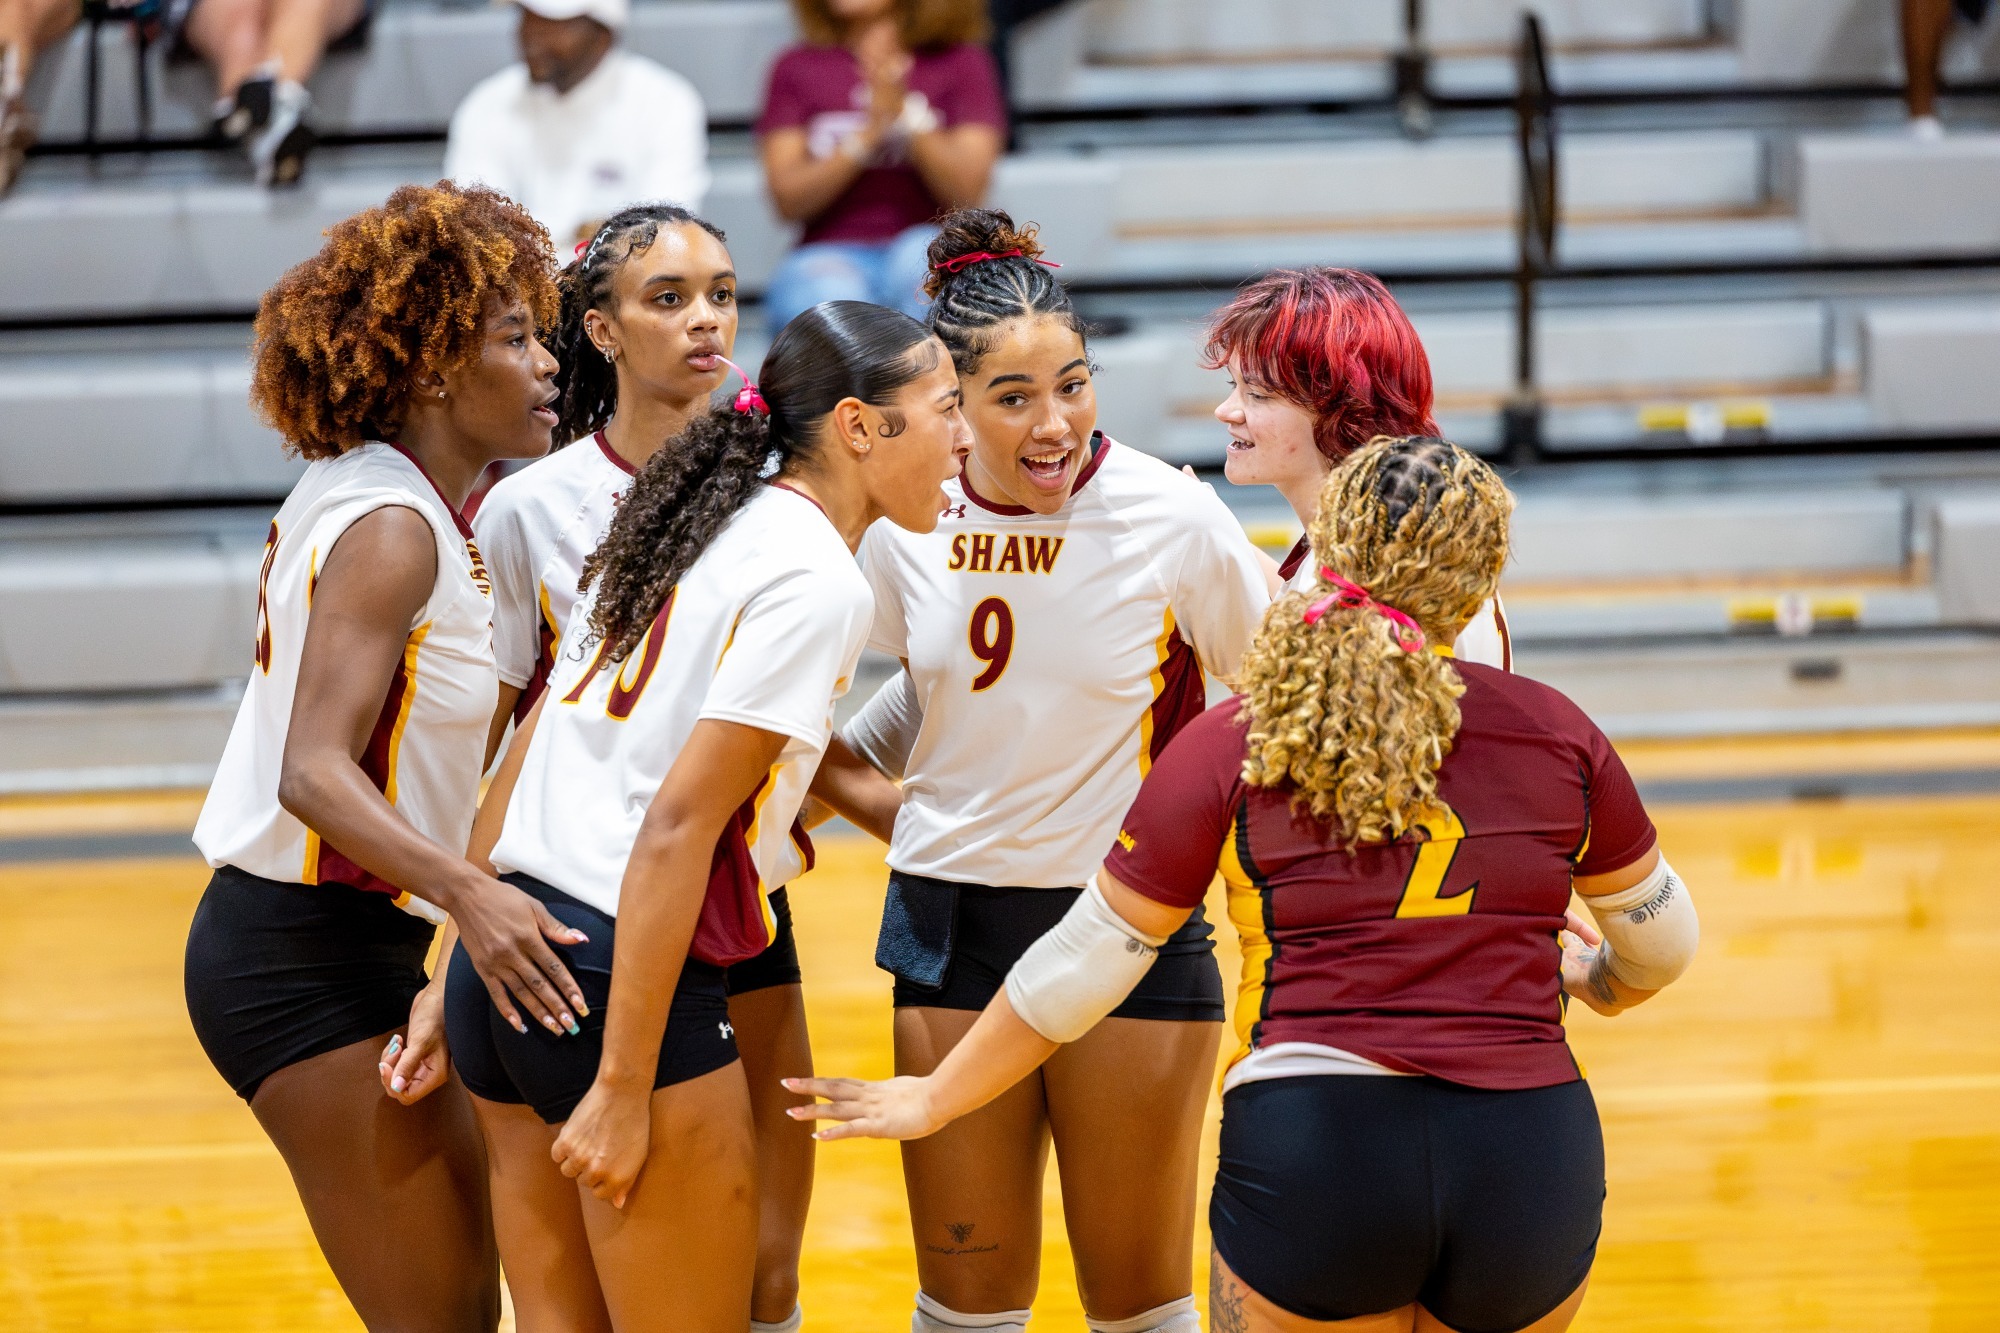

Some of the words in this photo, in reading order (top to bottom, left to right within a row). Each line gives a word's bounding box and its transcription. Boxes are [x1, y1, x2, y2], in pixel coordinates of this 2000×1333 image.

[948, 532, 1065, 575] SHAW
[968, 595, 1015, 693] 9
[1390, 803, 1480, 919] 2
